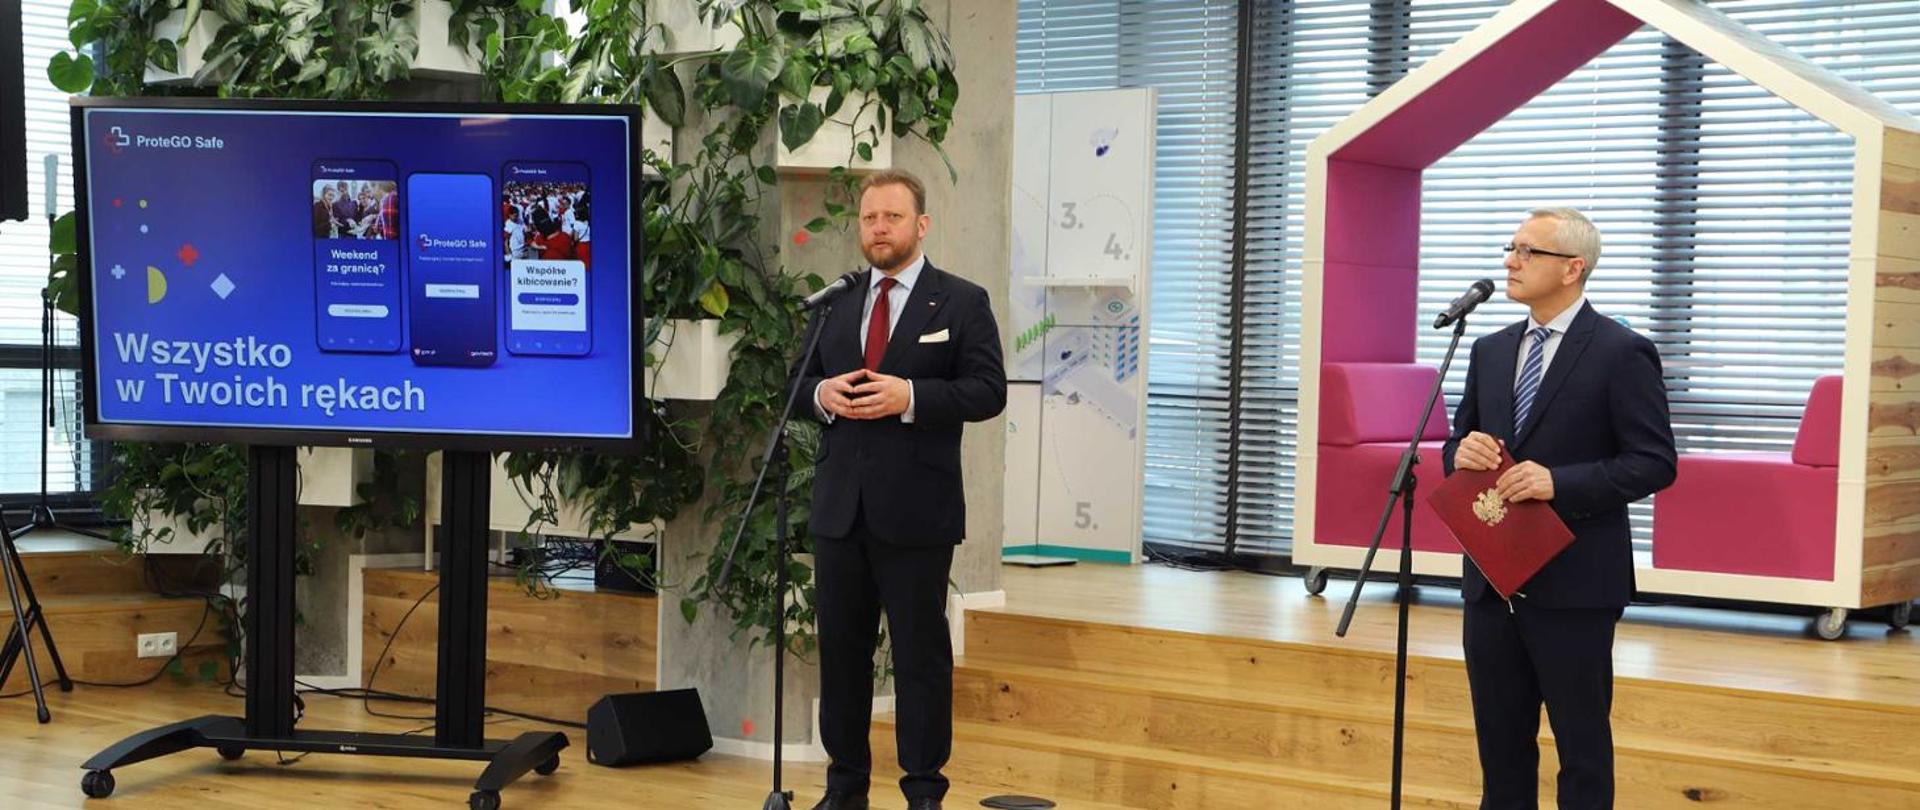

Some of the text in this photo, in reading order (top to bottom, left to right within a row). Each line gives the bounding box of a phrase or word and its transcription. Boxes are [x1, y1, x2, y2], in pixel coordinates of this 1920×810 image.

[136, 135, 224, 149] ProteGO Safe
[1060, 201, 1084, 230] 3.
[331, 249, 378, 260] Weekend
[433, 239, 487, 249] ProteGO Safe
[1103, 232, 1131, 261] 4.
[327, 263, 386, 276] za granicą?
[517, 277, 578, 288] kibicowanie?
[114, 332, 292, 373] Wszystko
[116, 373, 426, 416] w Twoich rękach
[1074, 501, 1099, 530] 5.
